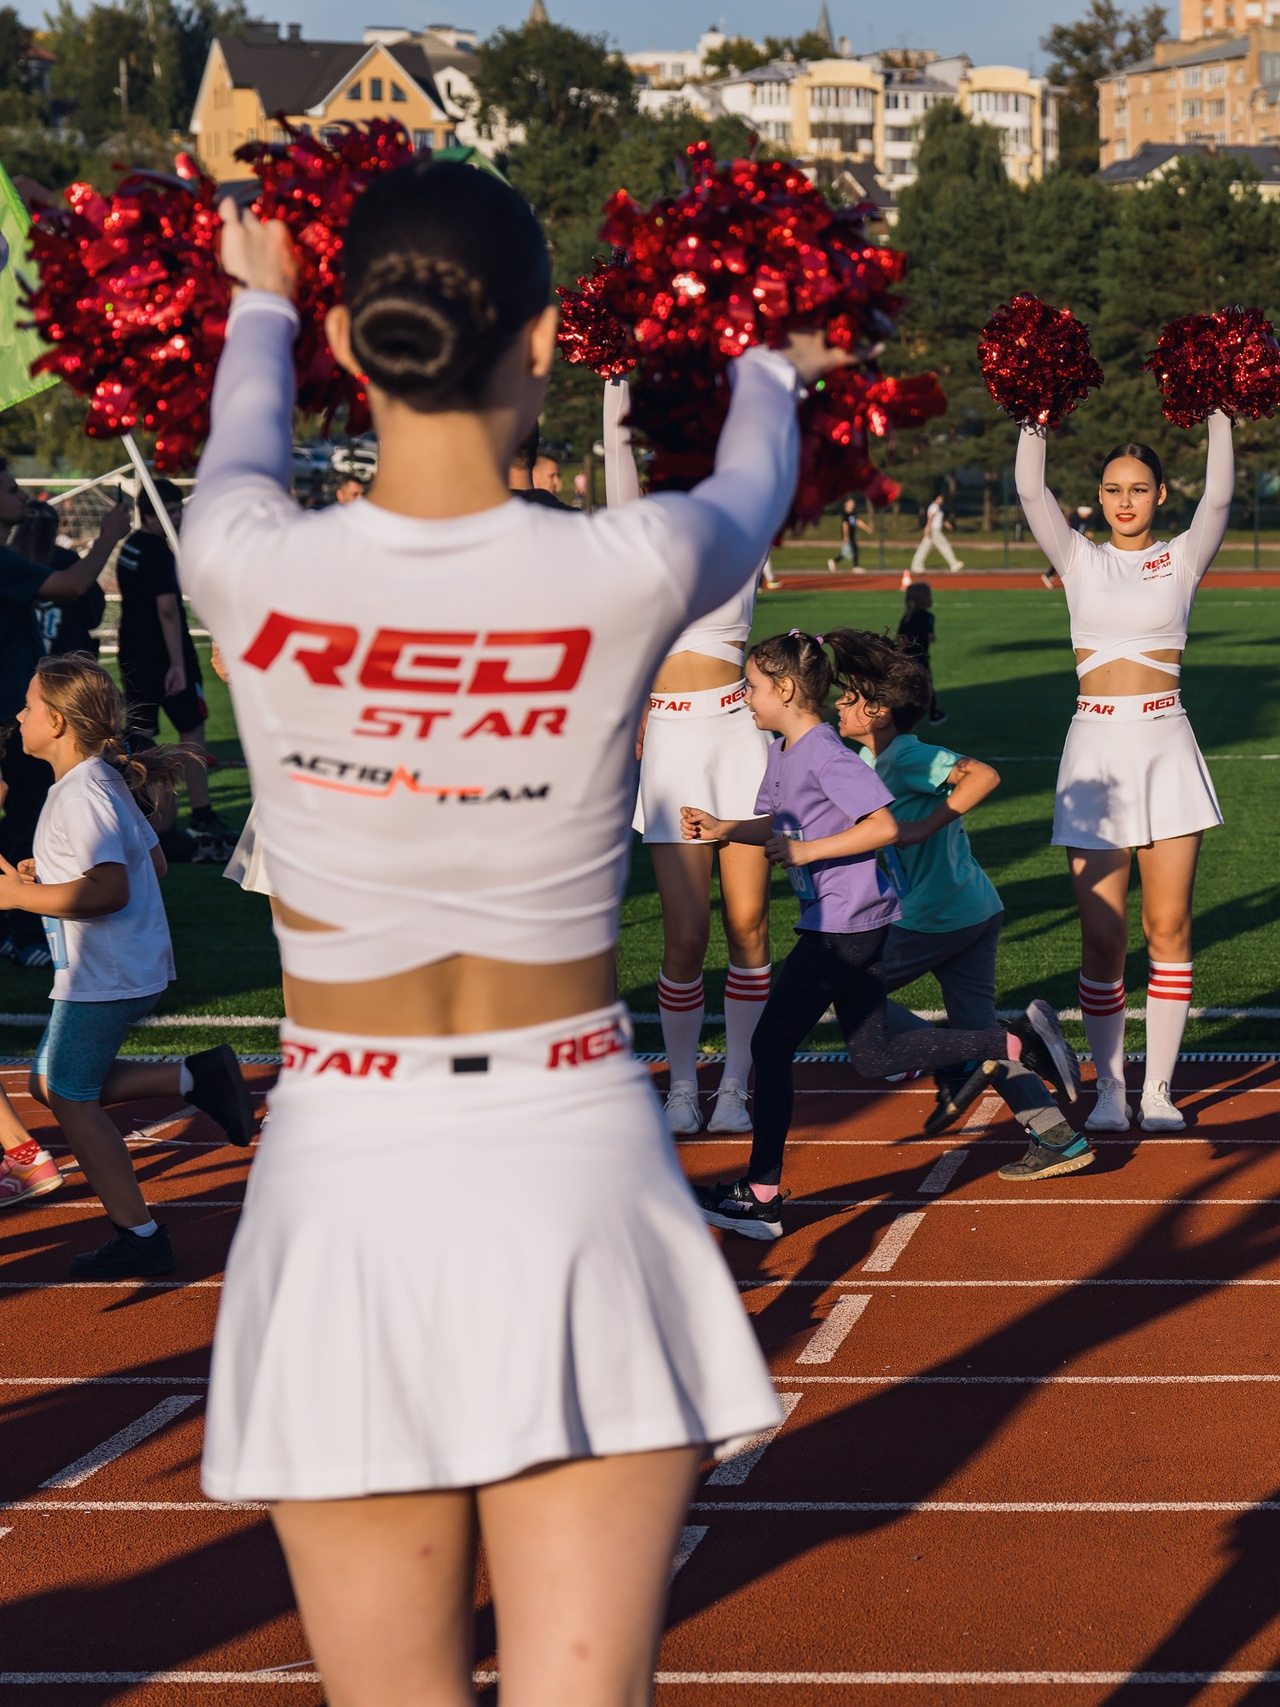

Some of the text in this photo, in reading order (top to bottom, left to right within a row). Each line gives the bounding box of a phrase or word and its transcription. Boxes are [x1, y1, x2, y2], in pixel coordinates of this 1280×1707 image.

[1141, 552, 1170, 571] RED
[241, 610, 592, 696] RED
[1142, 696, 1175, 713] RED
[353, 706, 568, 740] STAR
